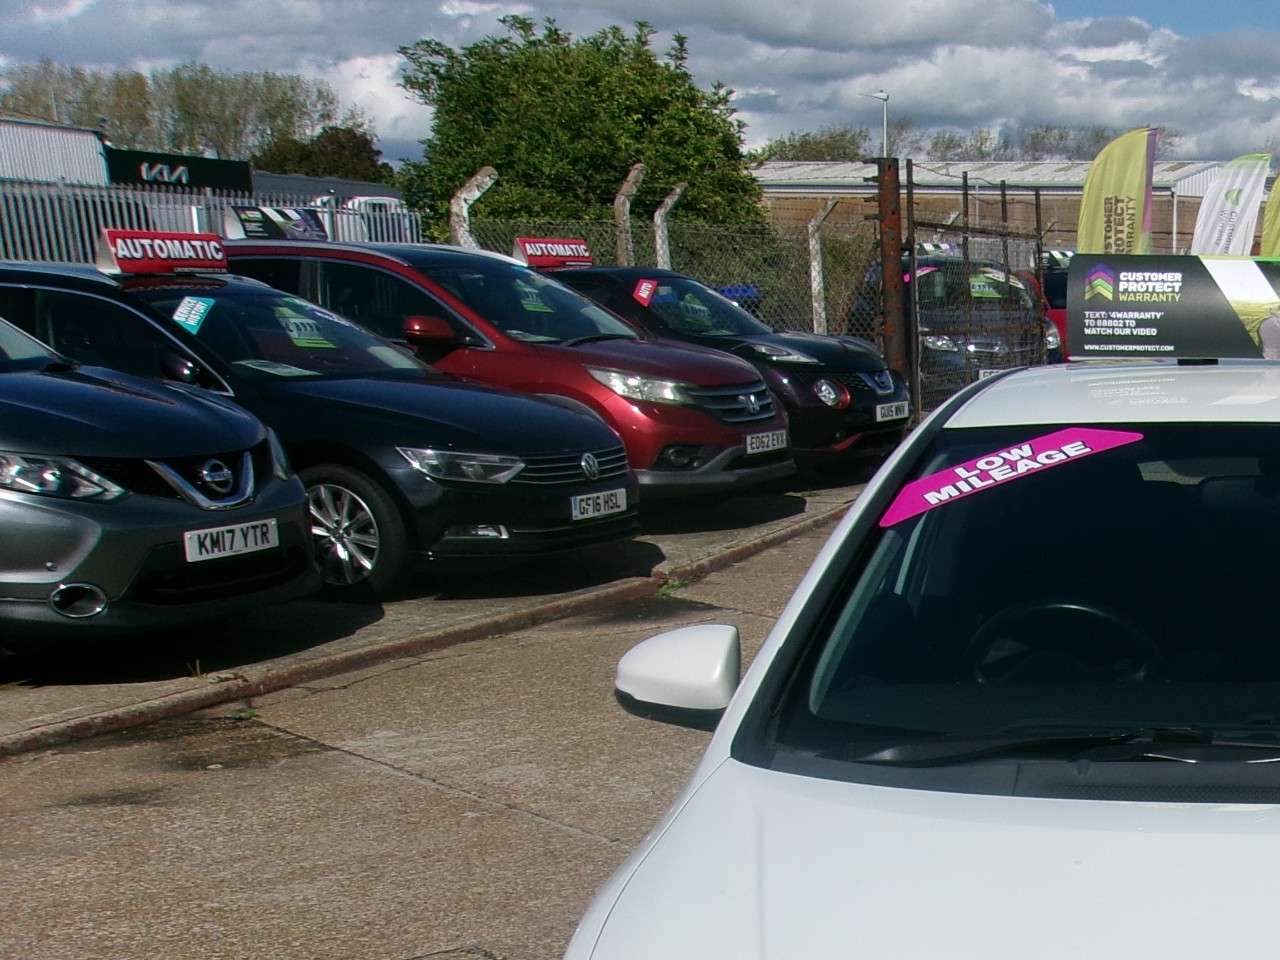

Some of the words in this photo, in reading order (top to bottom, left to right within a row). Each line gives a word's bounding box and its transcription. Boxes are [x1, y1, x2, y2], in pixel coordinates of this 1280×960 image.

[1103, 196, 1113, 256] STOMER
[1113, 195, 1125, 256] ROTECT
[1126, 195, 1136, 255] RRANTY
[115, 237, 224, 260] AUTOMATIC
[525, 242, 590, 257] AUTOMATIC
[1119, 272, 1182, 281] CUSTOMER
[1119, 282, 1182, 292] PROTECT
[1118, 293, 1182, 302] WARRANTY
[1084, 311, 1108, 319] TEXT:
[1084, 327, 1112, 335] WATCH
[1114, 328, 1131, 336] OUR
[1132, 328, 1157, 336] VIDEO
[953, 443, 1037, 479] LOW
[923, 441, 1092, 505] MILEAGE
[197, 529, 236, 556] KM17
[241, 523, 270, 548] YTR
